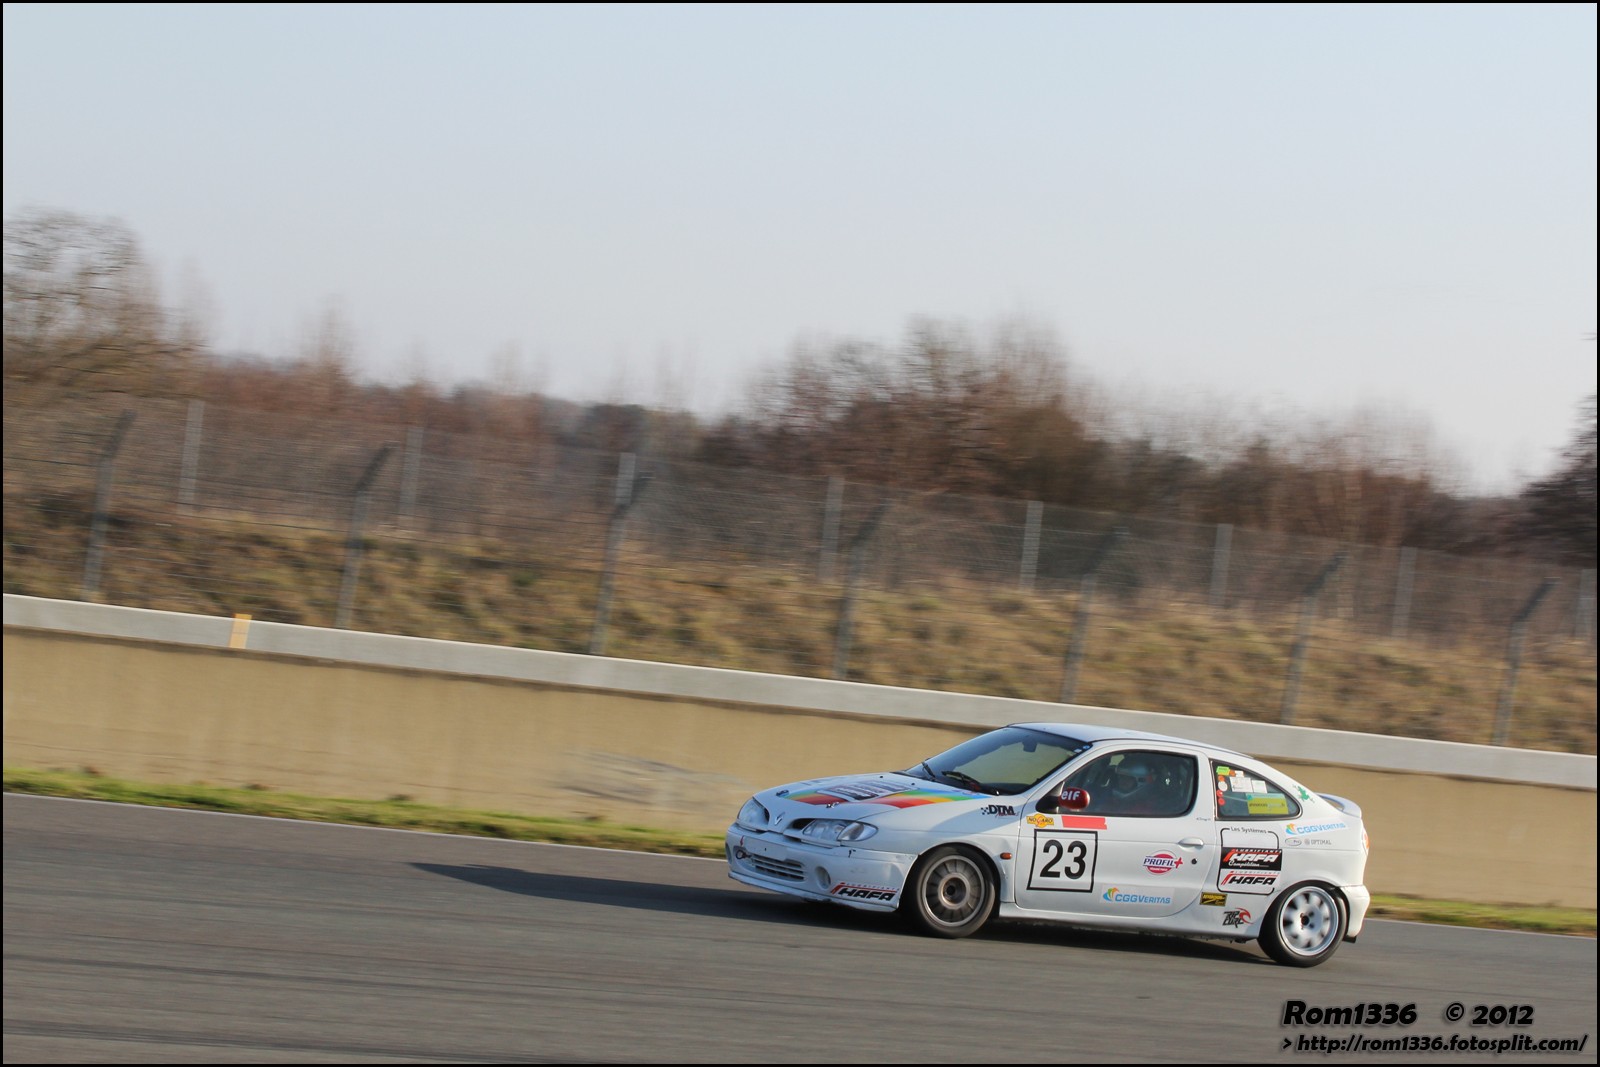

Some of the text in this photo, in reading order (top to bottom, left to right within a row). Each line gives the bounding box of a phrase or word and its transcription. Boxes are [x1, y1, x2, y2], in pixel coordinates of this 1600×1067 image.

[988, 804, 1016, 816] DTM
[1039, 839, 1087, 880] 23
[1229, 853, 1279, 863] HAFA
[1228, 876, 1277, 886] HAFA
[838, 887, 896, 901] HAFA
